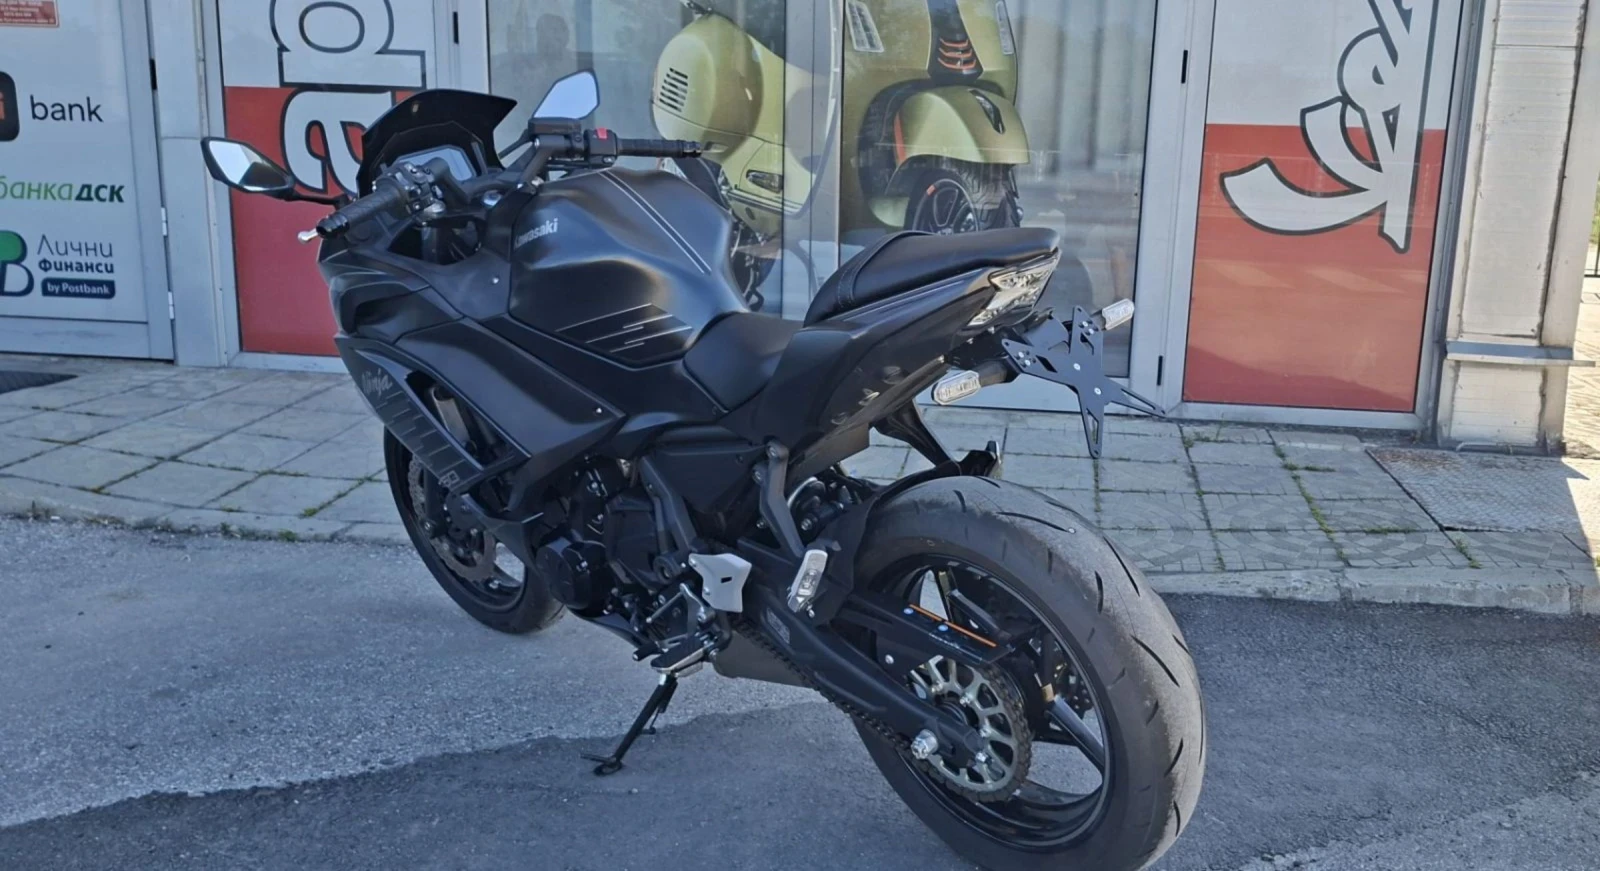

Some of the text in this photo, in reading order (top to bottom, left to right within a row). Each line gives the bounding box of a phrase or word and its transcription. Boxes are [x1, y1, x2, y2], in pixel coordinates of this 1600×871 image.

[30, 94, 104, 123] bank
[37, 233, 113, 258] Лични
[38, 258, 115, 274] Финанси
[47, 281, 111, 295] by Postbank
